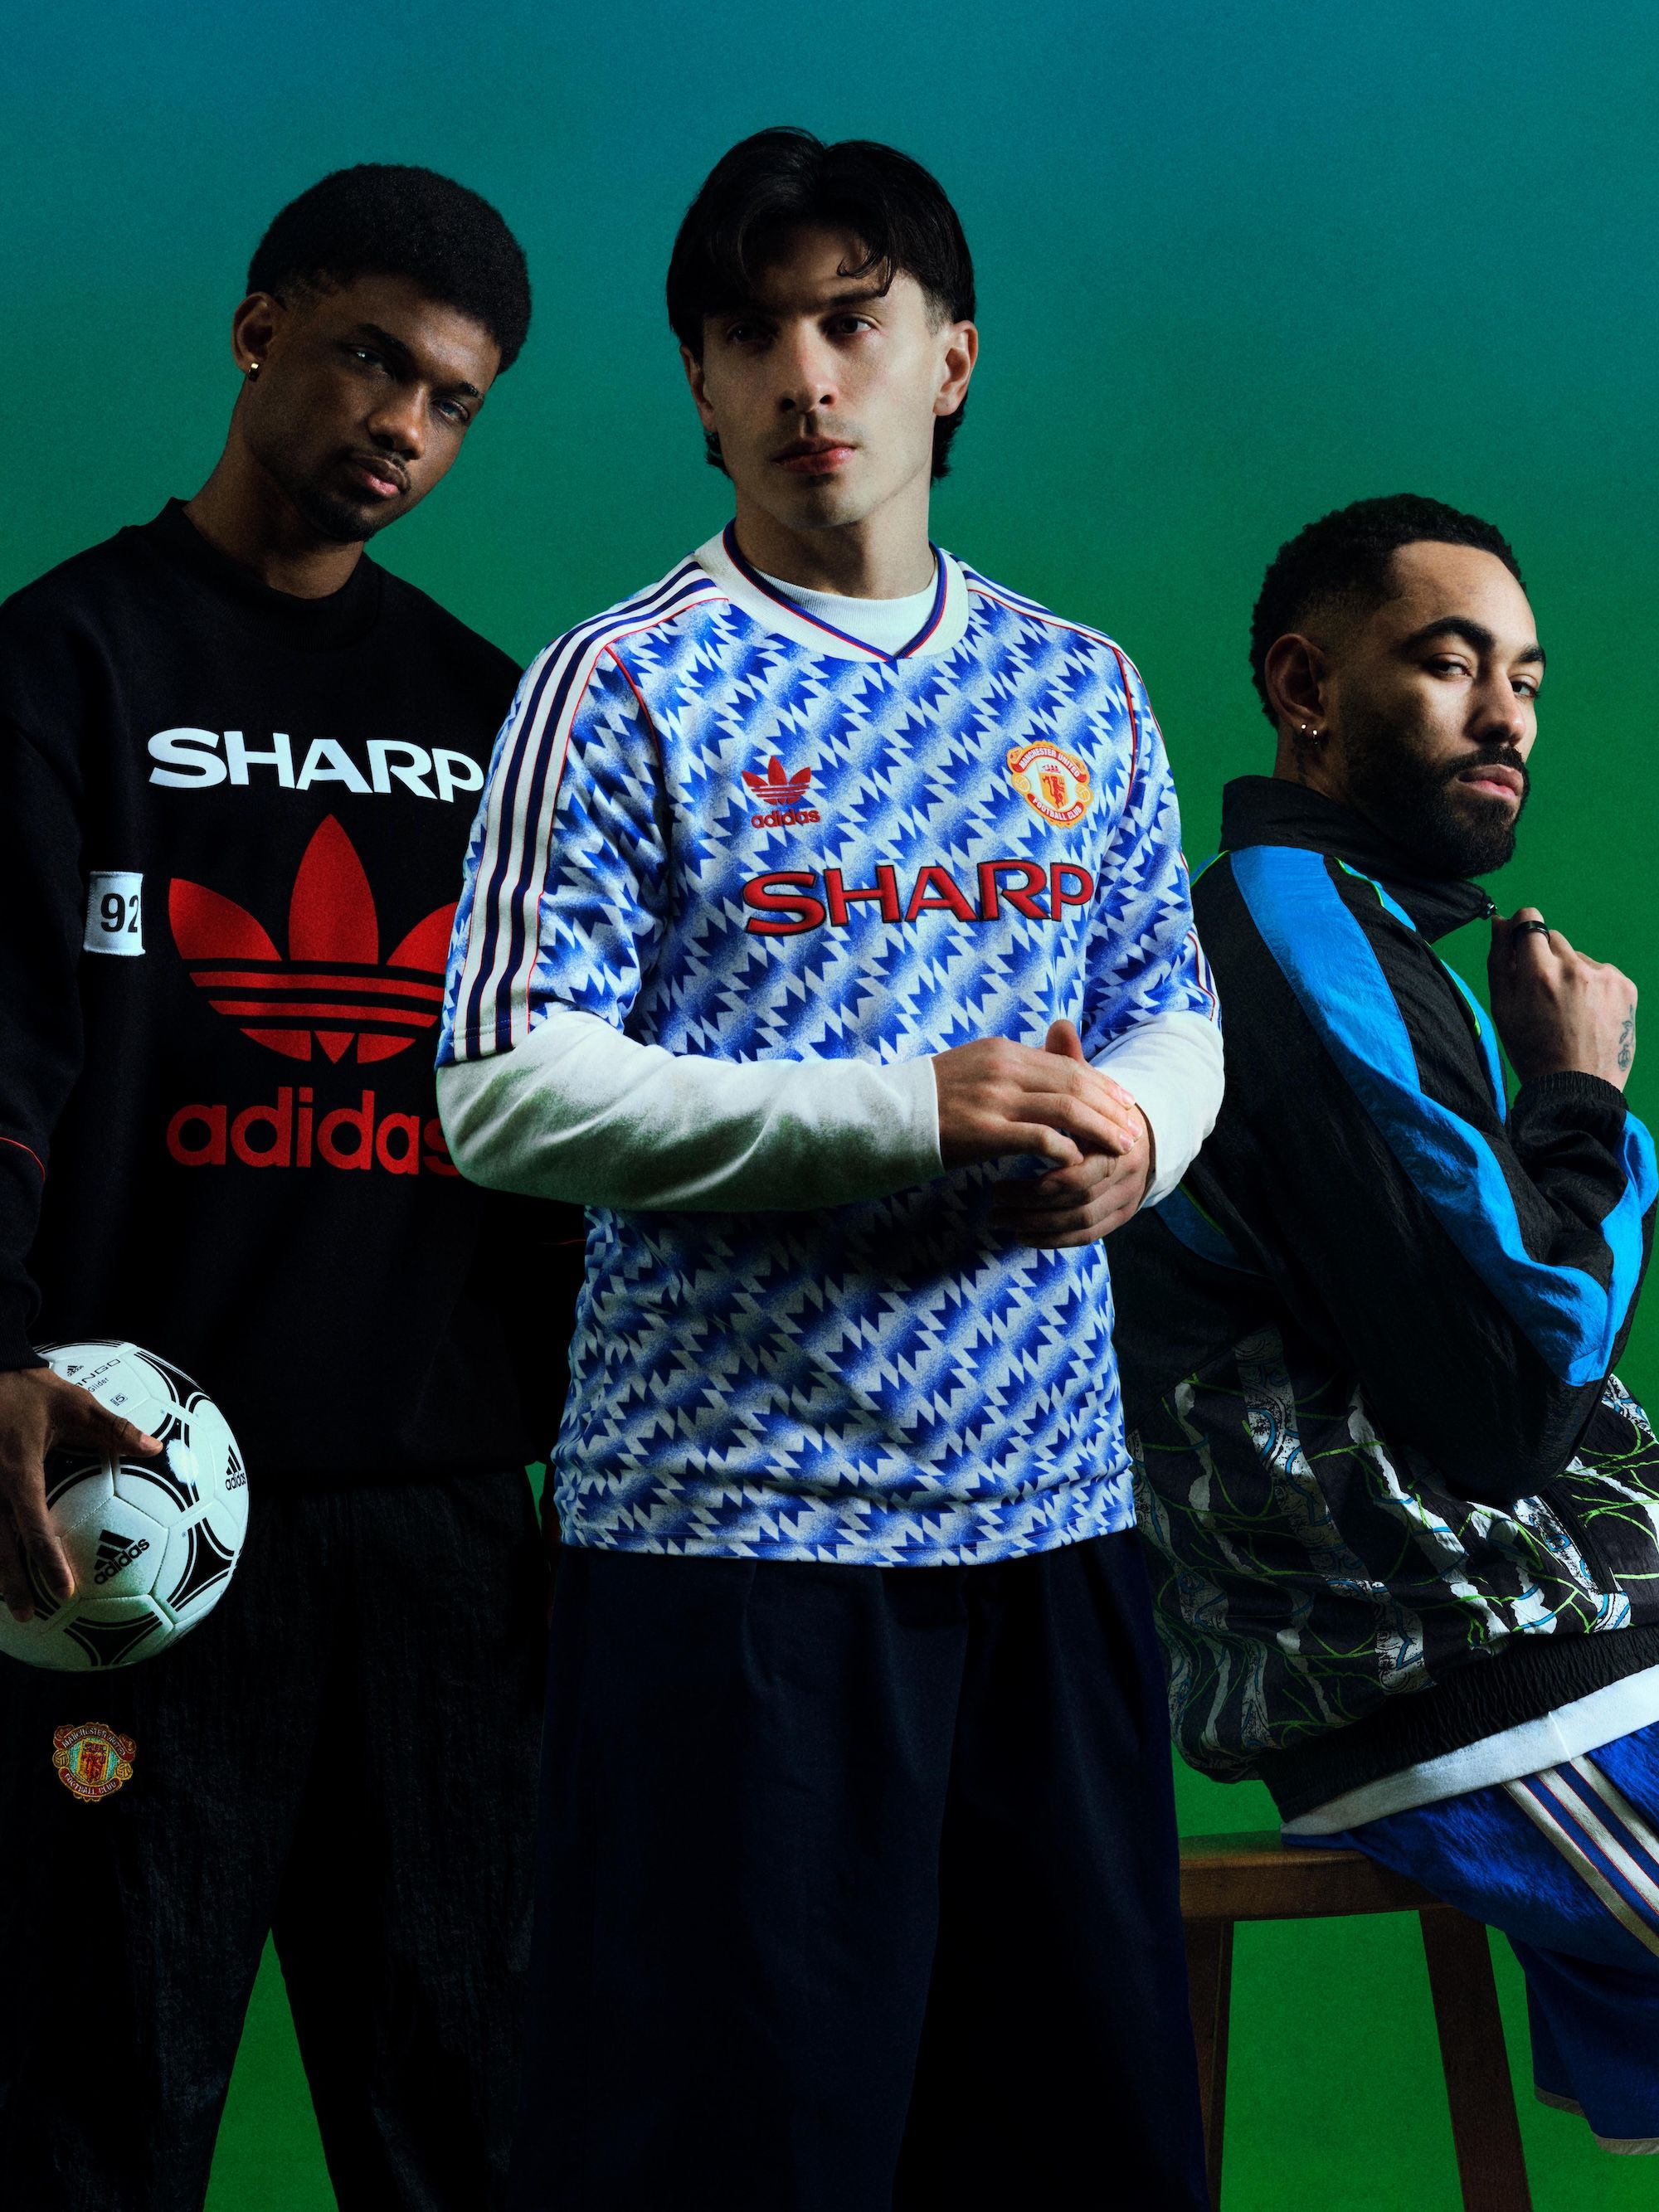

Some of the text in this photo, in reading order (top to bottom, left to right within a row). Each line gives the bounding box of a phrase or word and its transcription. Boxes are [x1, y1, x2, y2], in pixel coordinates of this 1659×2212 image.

[148, 727, 484, 803] SHARP
[1018, 747, 1081, 778] MANCHESTER UNITED
[751, 808, 821, 829] adidas
[1033, 797, 1082, 820] FOOTBALL CLUB
[742, 859, 1094, 936] SHARP
[100, 892, 139, 933] 92
[87, 1378, 109, 1393] Glider
[115, 1394, 125, 1403] 5
[225, 1472, 246, 1490] adidas
[94, 1539, 150, 1585] adidas
